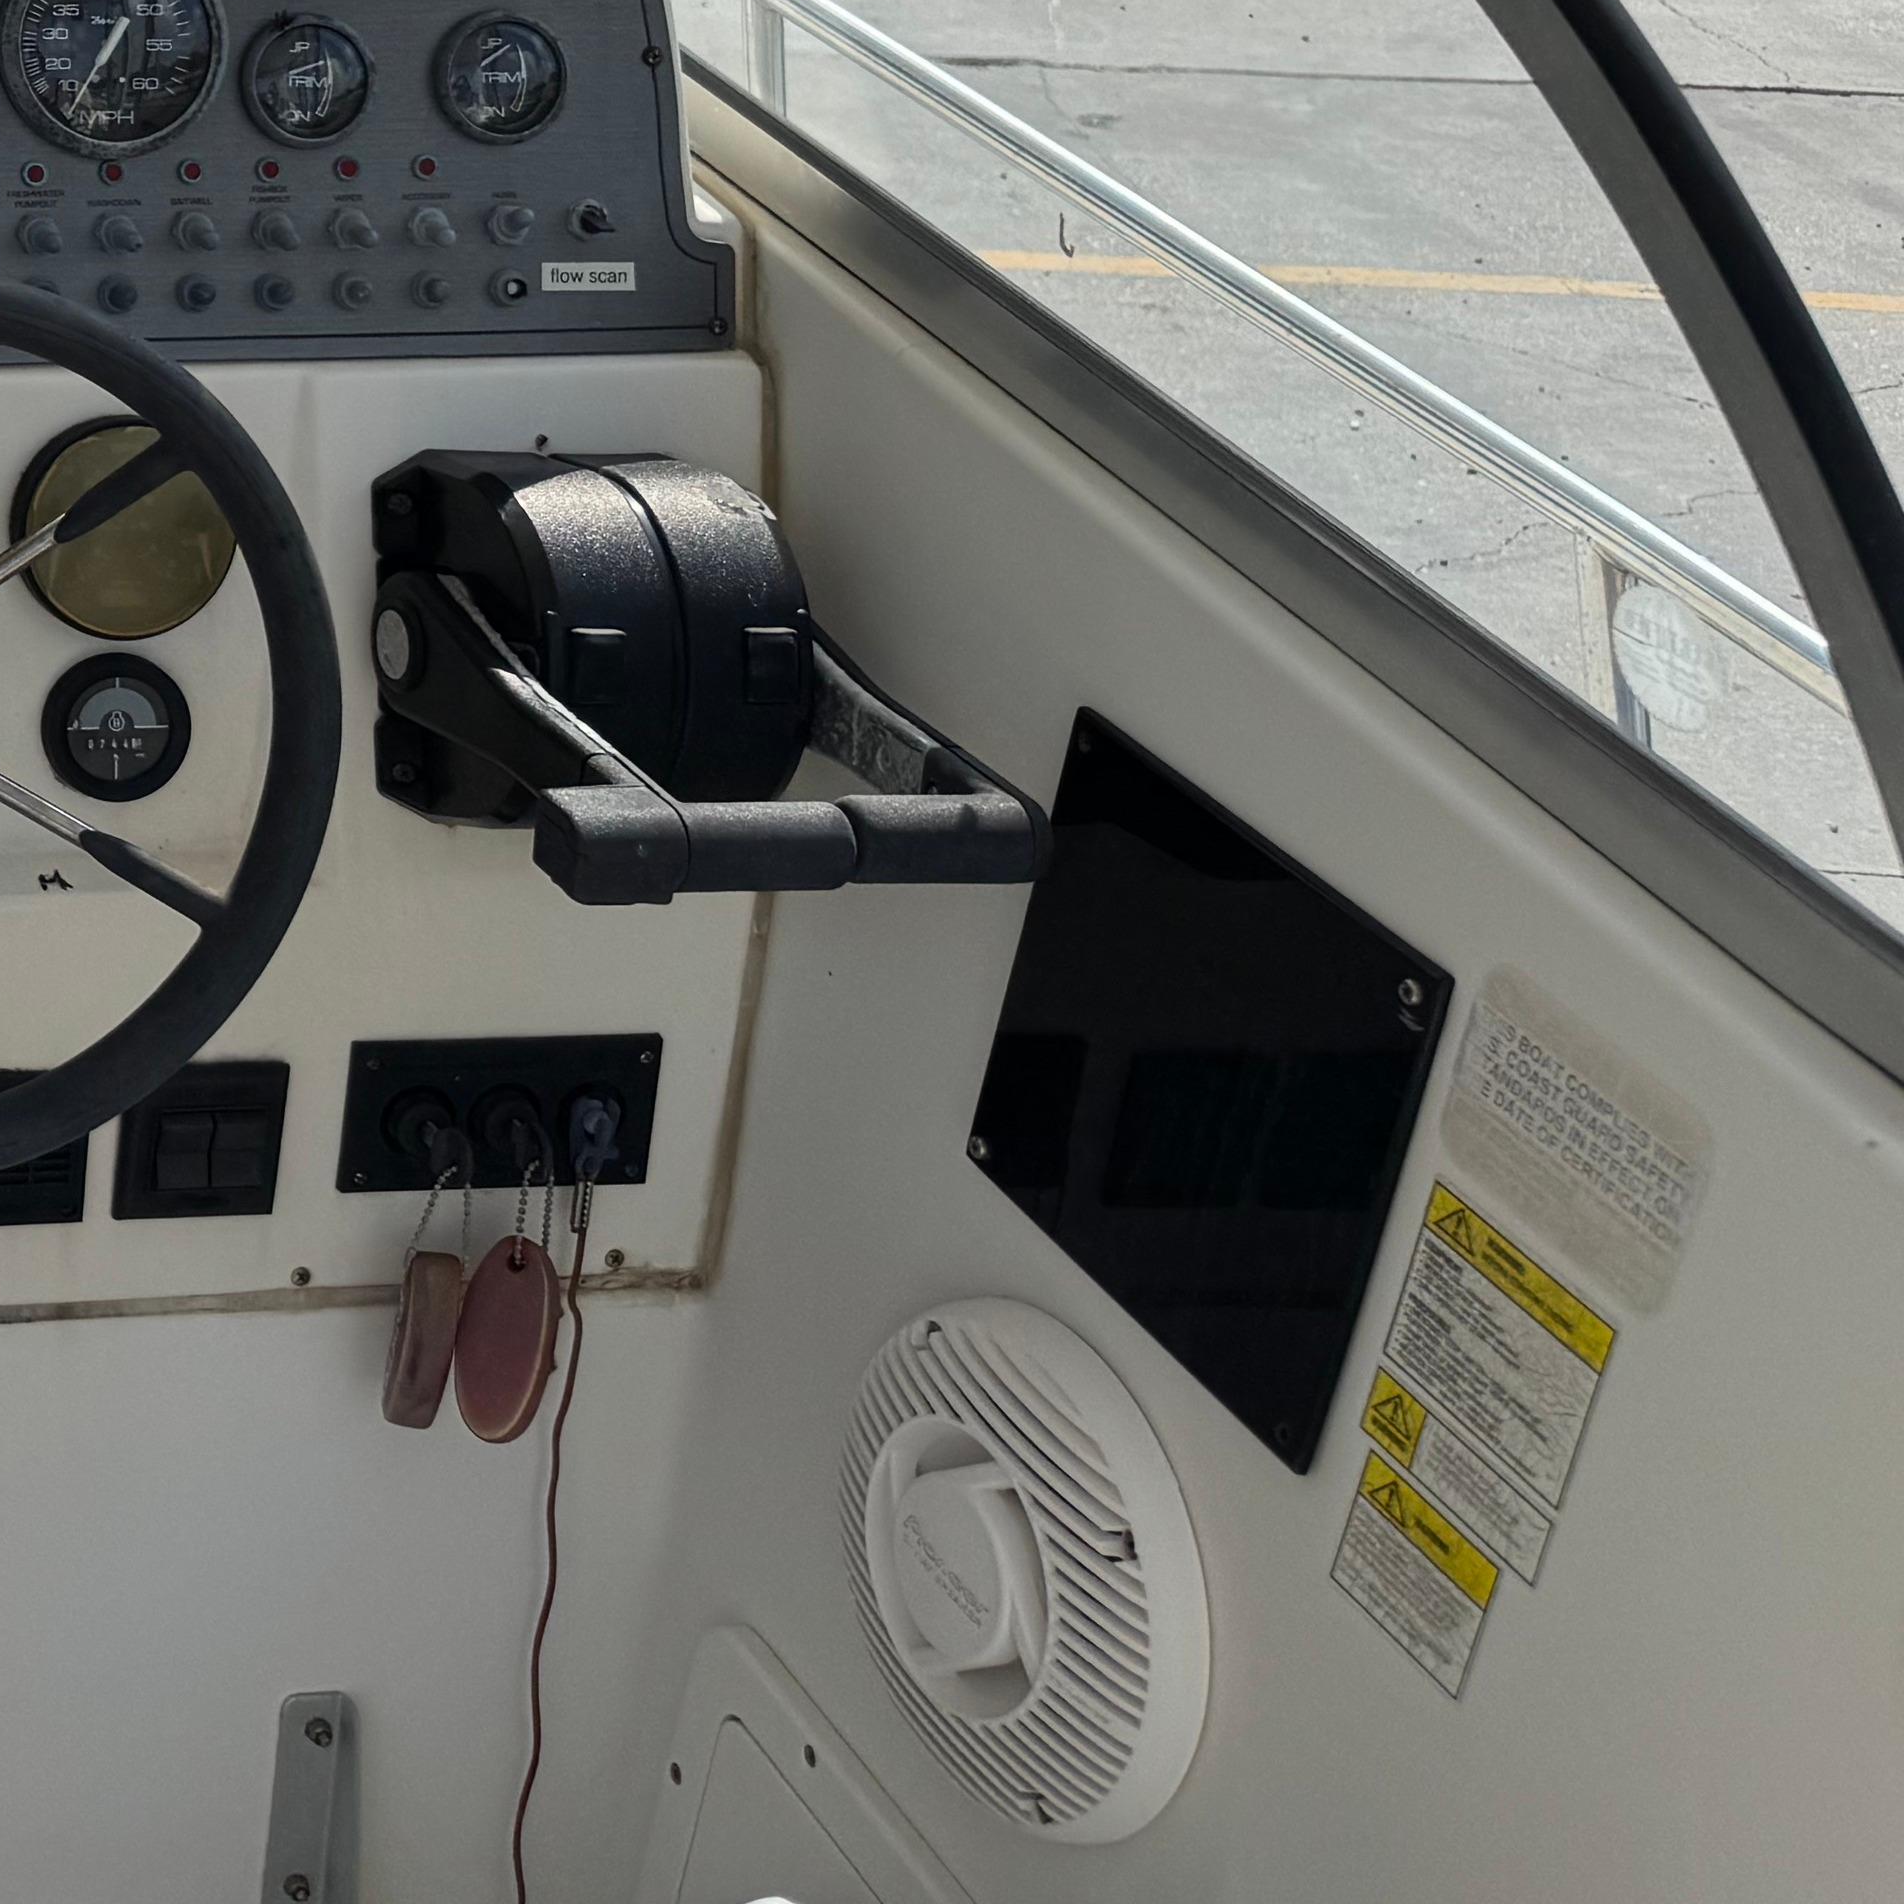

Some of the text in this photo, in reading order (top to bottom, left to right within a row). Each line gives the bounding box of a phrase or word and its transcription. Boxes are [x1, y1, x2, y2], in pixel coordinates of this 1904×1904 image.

[52, 3, 164, 16] 35 50
[42, 27, 69, 40] 30
[146, 38, 173, 51] 55
[45, 57, 72, 70] 20
[57, 77, 159, 92] 10 60
[288, 75, 328, 88] TRIM
[480, 71, 521, 84] TRIM
[79, 110, 135, 125] MPH
[550, 267, 628, 284] flow scan
[1518, 1035, 1689, 1175] BOAT COMPLIES WIT
[1493, 1090, 1535, 1134] DATE
[1535, 1125, 1560, 1151] OF
[1505, 1050, 1564, 1101] COAST
[1563, 1097, 1623, 1153] GUARD
[1623, 1145, 1686, 1198] SAFET
[1567, 1126, 1588, 1150] IN
[1587, 1142, 1654, 1201] EFFECT
